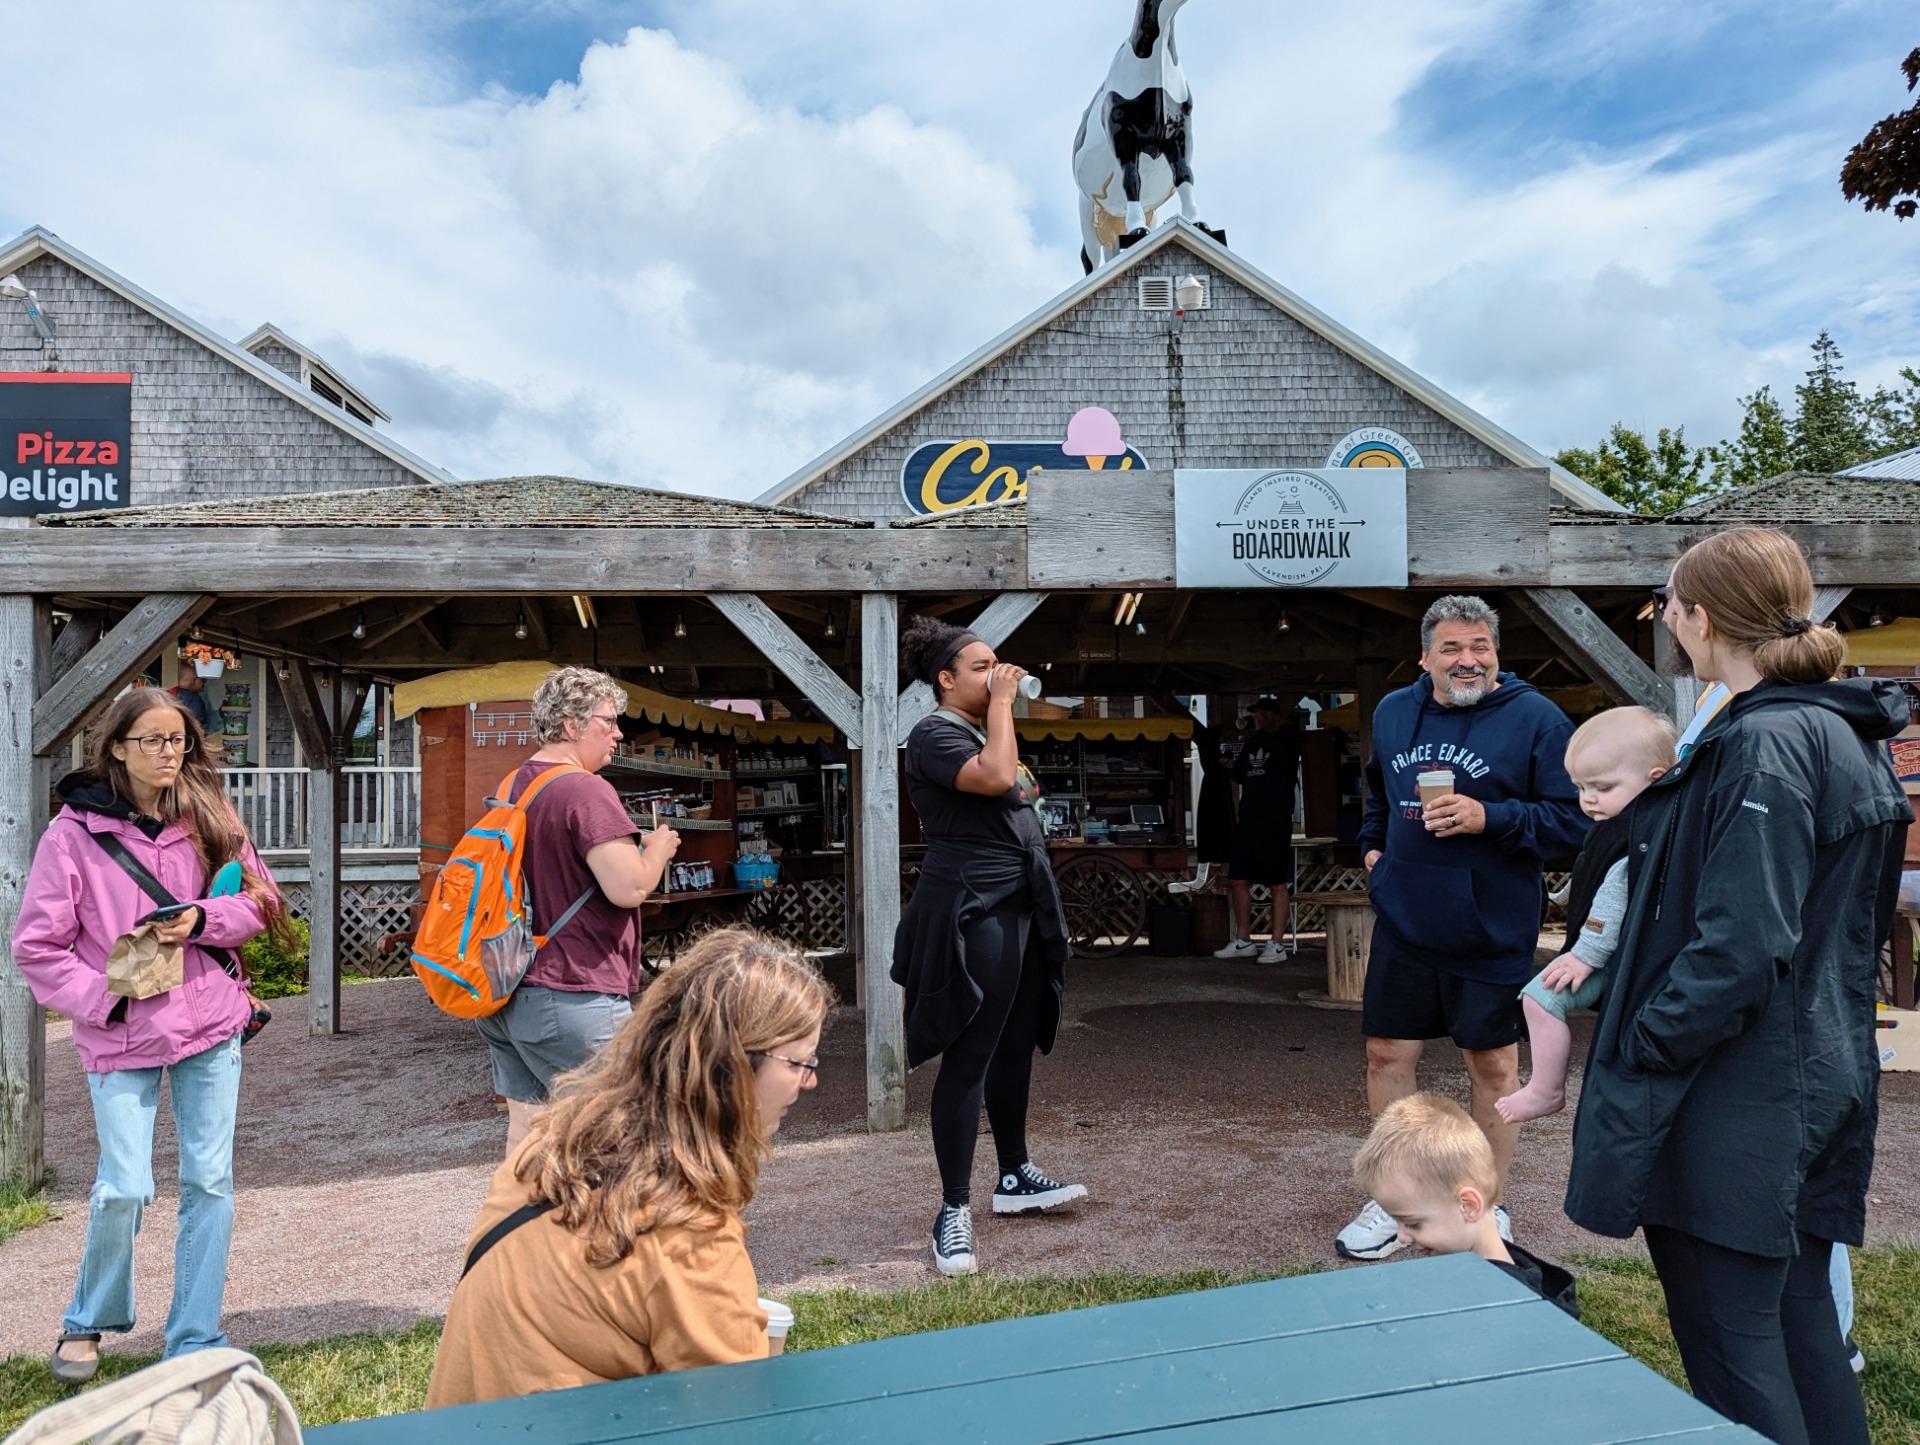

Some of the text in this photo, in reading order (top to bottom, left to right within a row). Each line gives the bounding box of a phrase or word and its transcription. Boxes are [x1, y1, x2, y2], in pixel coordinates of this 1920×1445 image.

[17, 431, 119, 465] Pizza
[1331, 451, 1343, 467] ne
[1344, 436, 1357, 450] of
[1360, 430, 1400, 446] Green
[1242, 476, 1340, 512] ISLAND INSPIRED CREATIONS
[1246, 518, 1335, 530] UNDER THE
[1232, 531, 1351, 560] BOARDWALK
[1261, 565, 1322, 580] CAVENDISH, PEI
[1391, 743, 1490, 779] PRINCE EDWARD
[1402, 807, 1421, 820] ISL
[1741, 798, 1769, 814] lumbia
